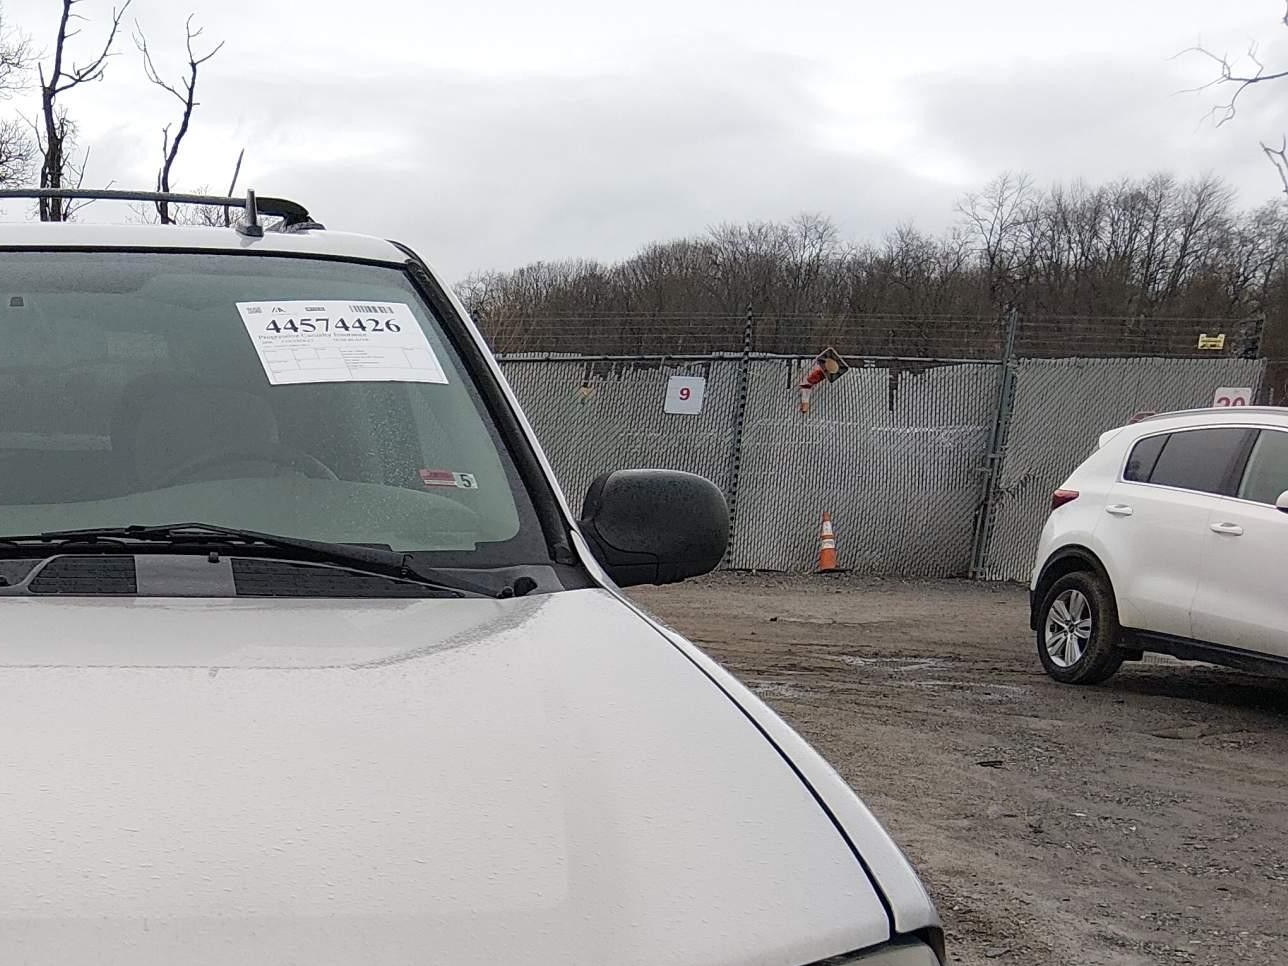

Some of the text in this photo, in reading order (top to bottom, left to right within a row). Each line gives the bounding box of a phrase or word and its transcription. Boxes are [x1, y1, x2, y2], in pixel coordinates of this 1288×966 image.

[265, 317, 401, 334] 44574426
[679, 387, 691, 401] 9
[459, 474, 472, 488] 5
